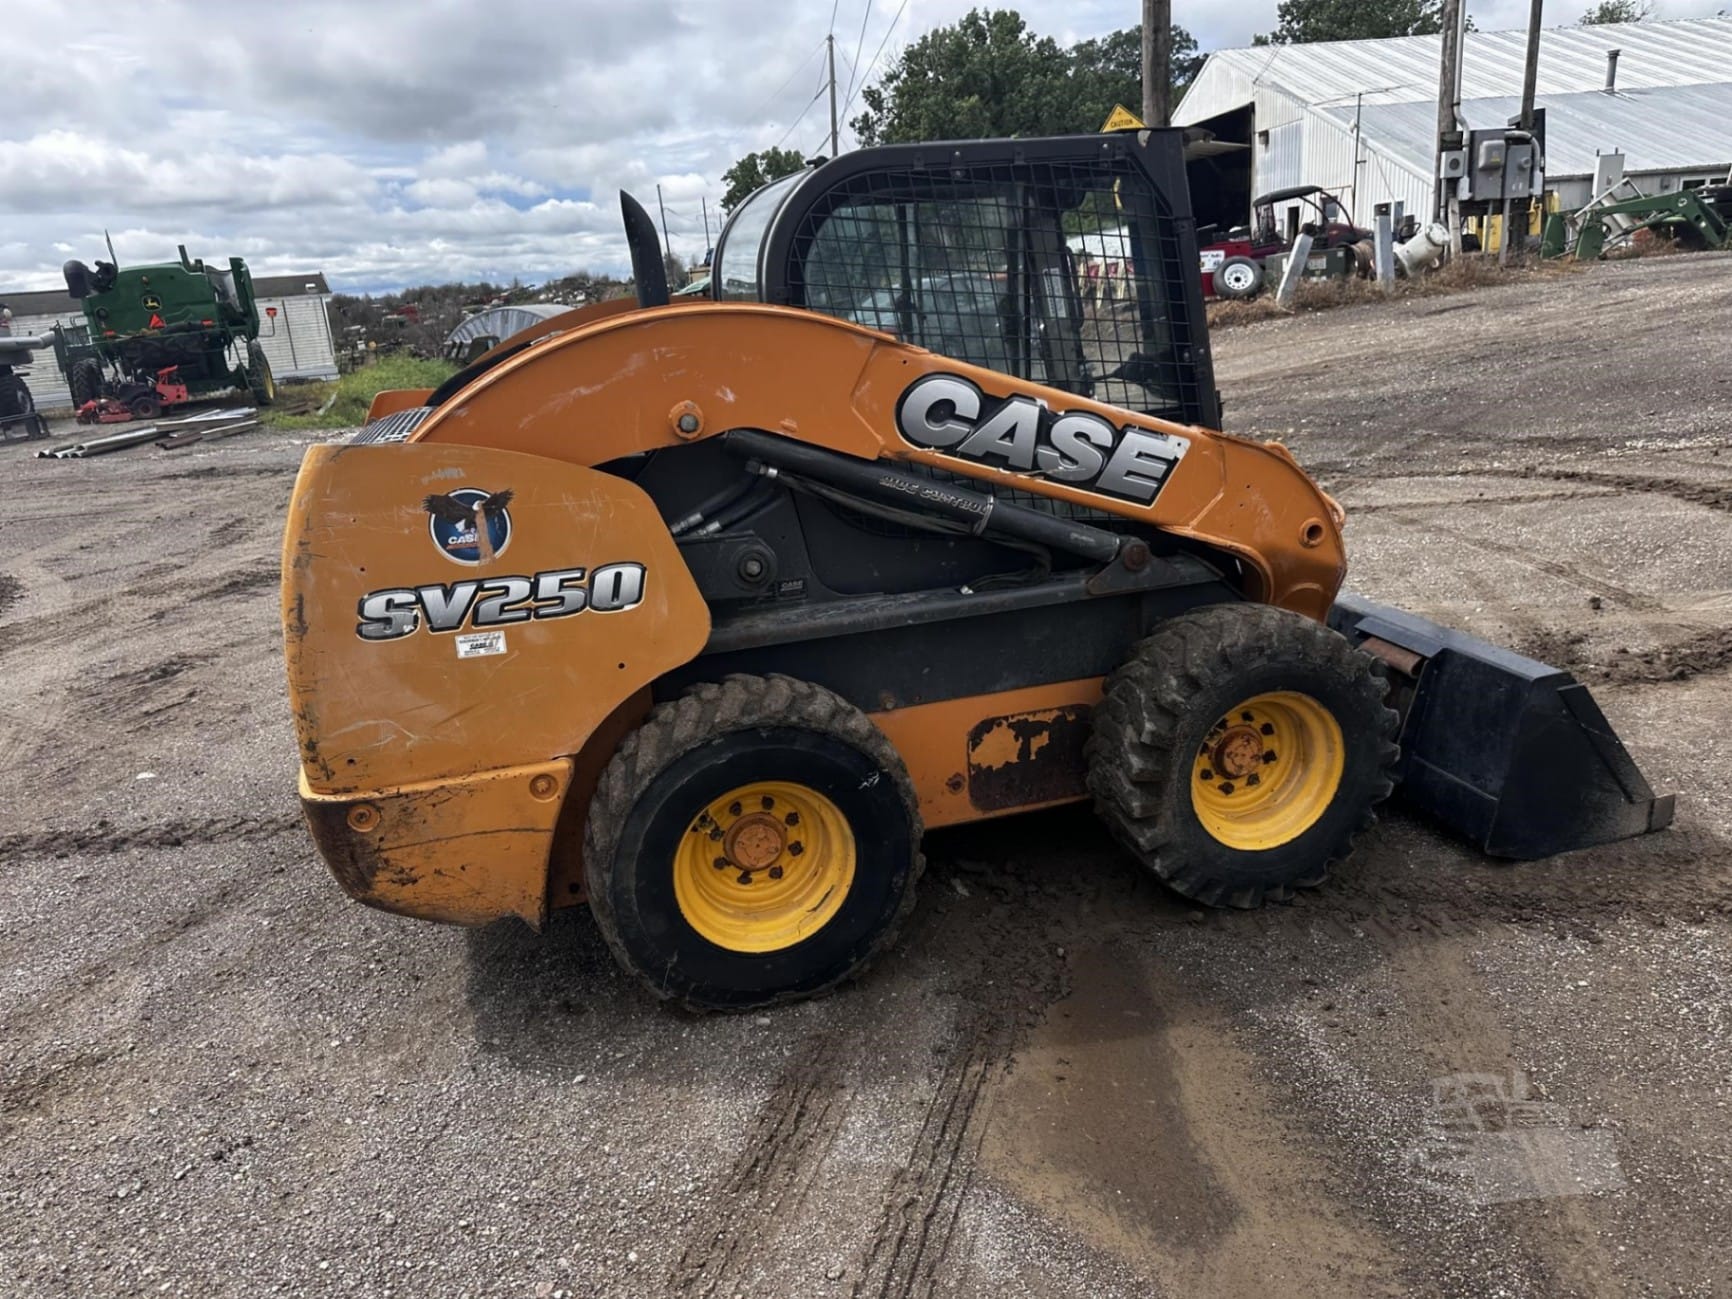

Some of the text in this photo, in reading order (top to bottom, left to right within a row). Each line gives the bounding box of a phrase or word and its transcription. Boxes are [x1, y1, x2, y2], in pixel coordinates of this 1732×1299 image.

[896, 374, 1187, 506] CASE
[447, 533, 478, 545] CAS
[356, 562, 647, 642] SV250
